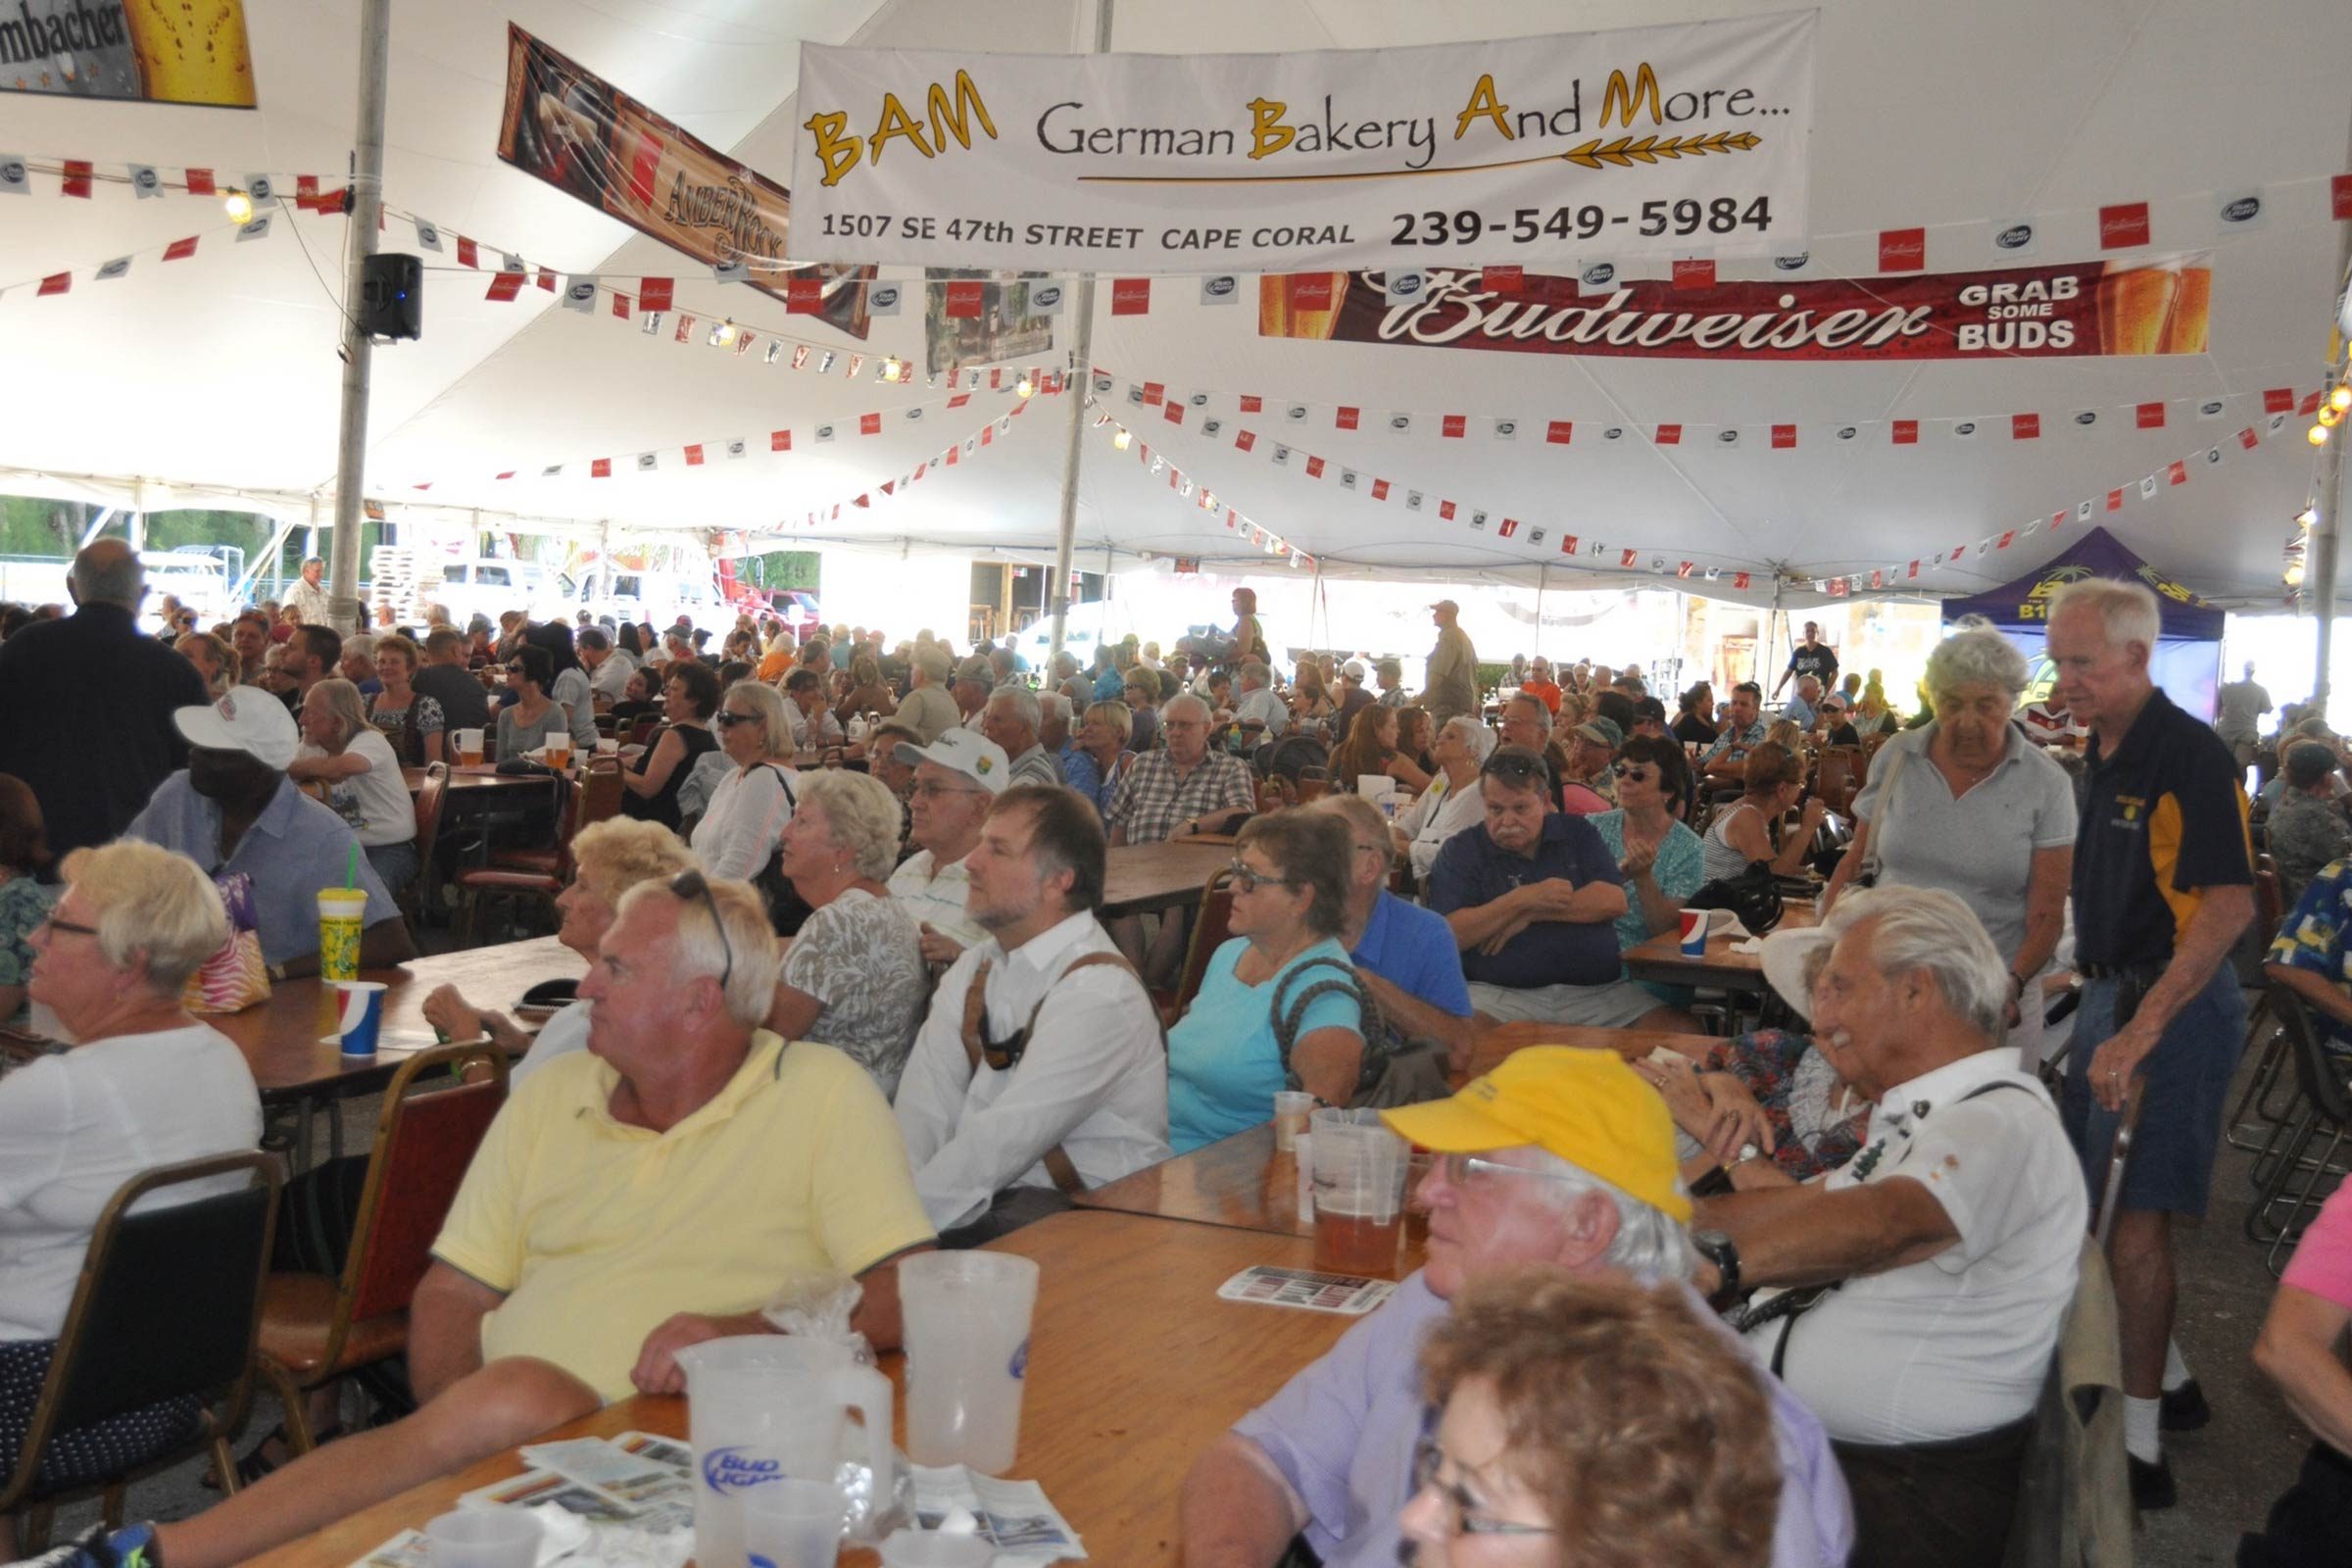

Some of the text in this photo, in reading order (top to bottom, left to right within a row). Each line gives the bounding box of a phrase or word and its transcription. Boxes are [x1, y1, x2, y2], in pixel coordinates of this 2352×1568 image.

[804, 63, 1789, 186] BAM German Bakery And More...
[822, 196, 1772, 249] 1507 SE 47th STREET CAPE CORAL 239-549-5984
[1959, 275, 2079, 306] GRAB
[1987, 303, 2053, 319] SOME
[1959, 320, 2075, 350] BUDS
[720, 1454, 780, 1473] BUD
